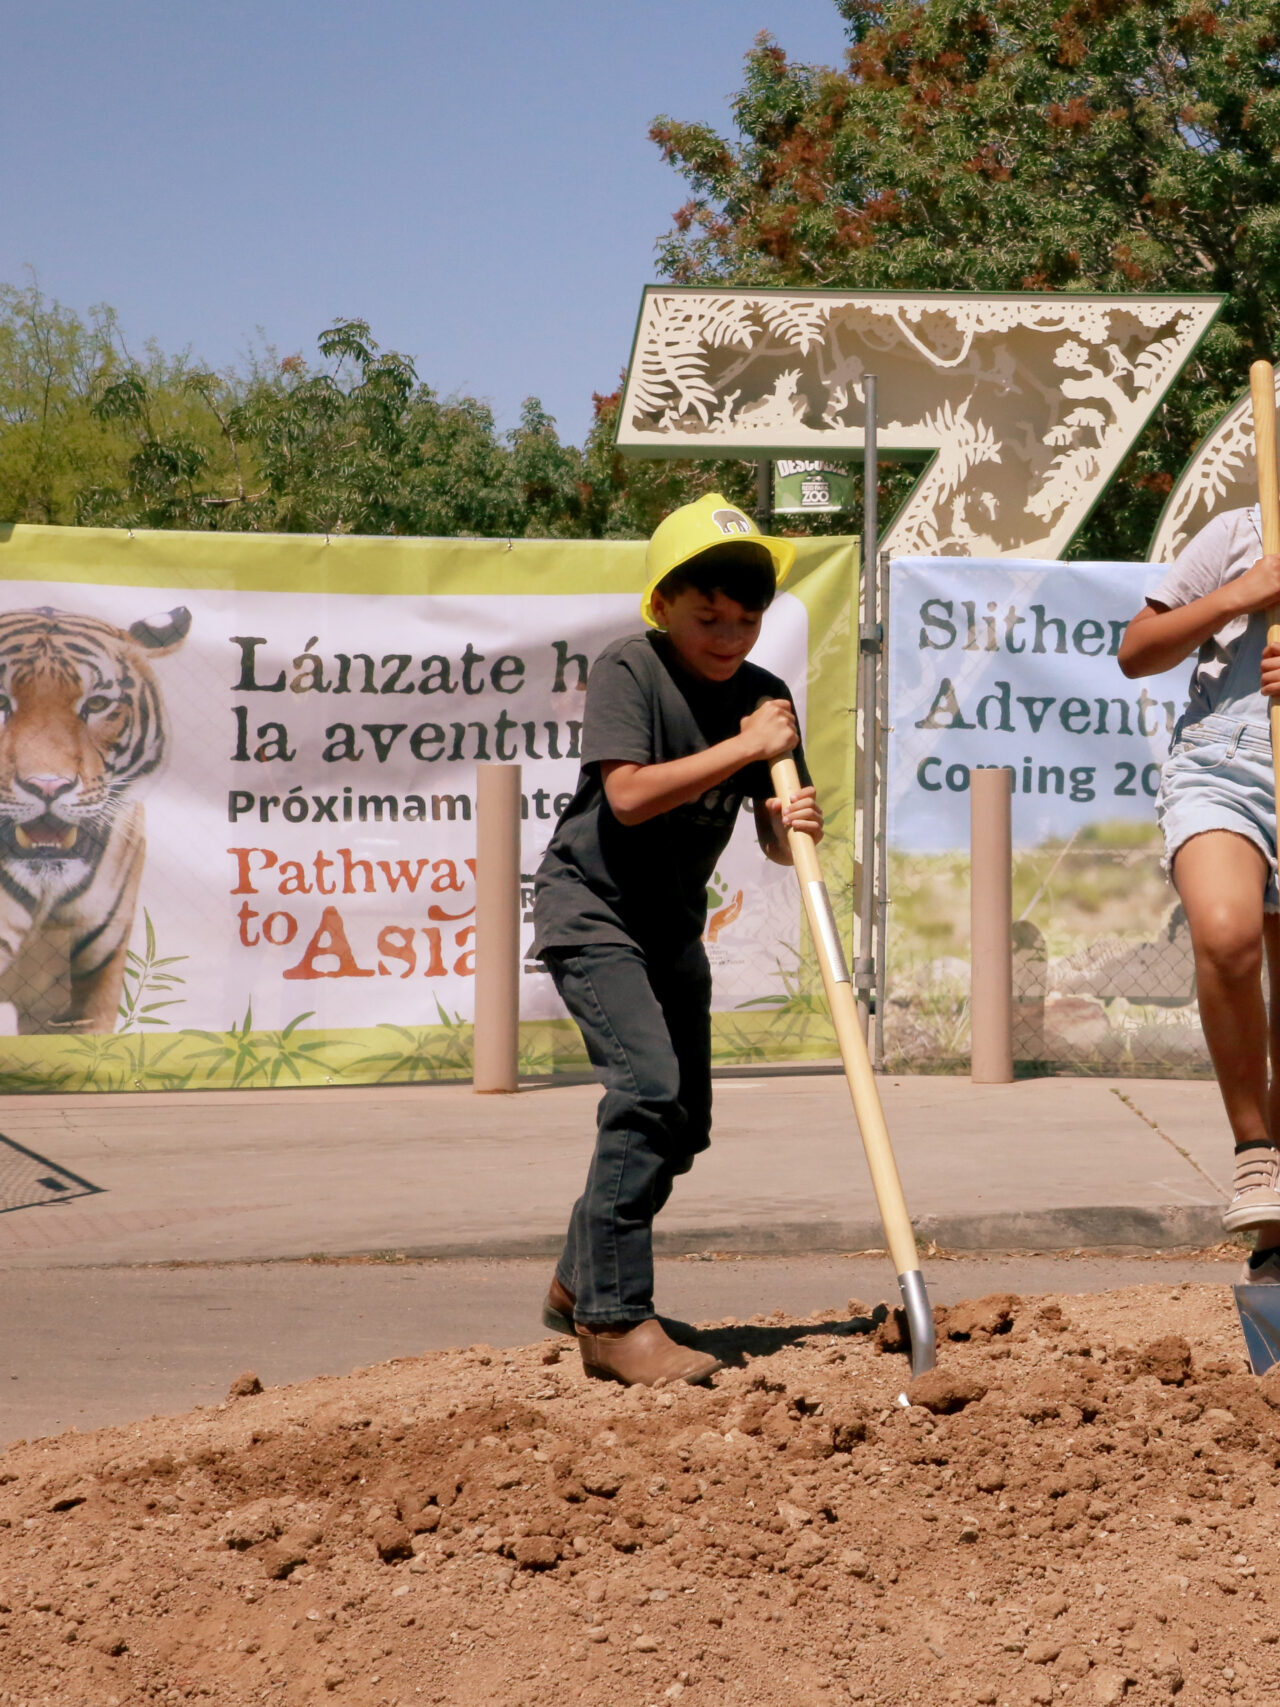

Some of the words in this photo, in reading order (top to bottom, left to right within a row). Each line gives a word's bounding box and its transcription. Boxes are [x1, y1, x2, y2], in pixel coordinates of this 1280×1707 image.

[801, 491, 829, 502] ZOO
[229, 636, 526, 695] Lánzate
[914, 677, 1190, 737] Adventu
[230, 705, 297, 763] la
[1113, 761, 1163, 797] 20
[237, 900, 298, 947] to
